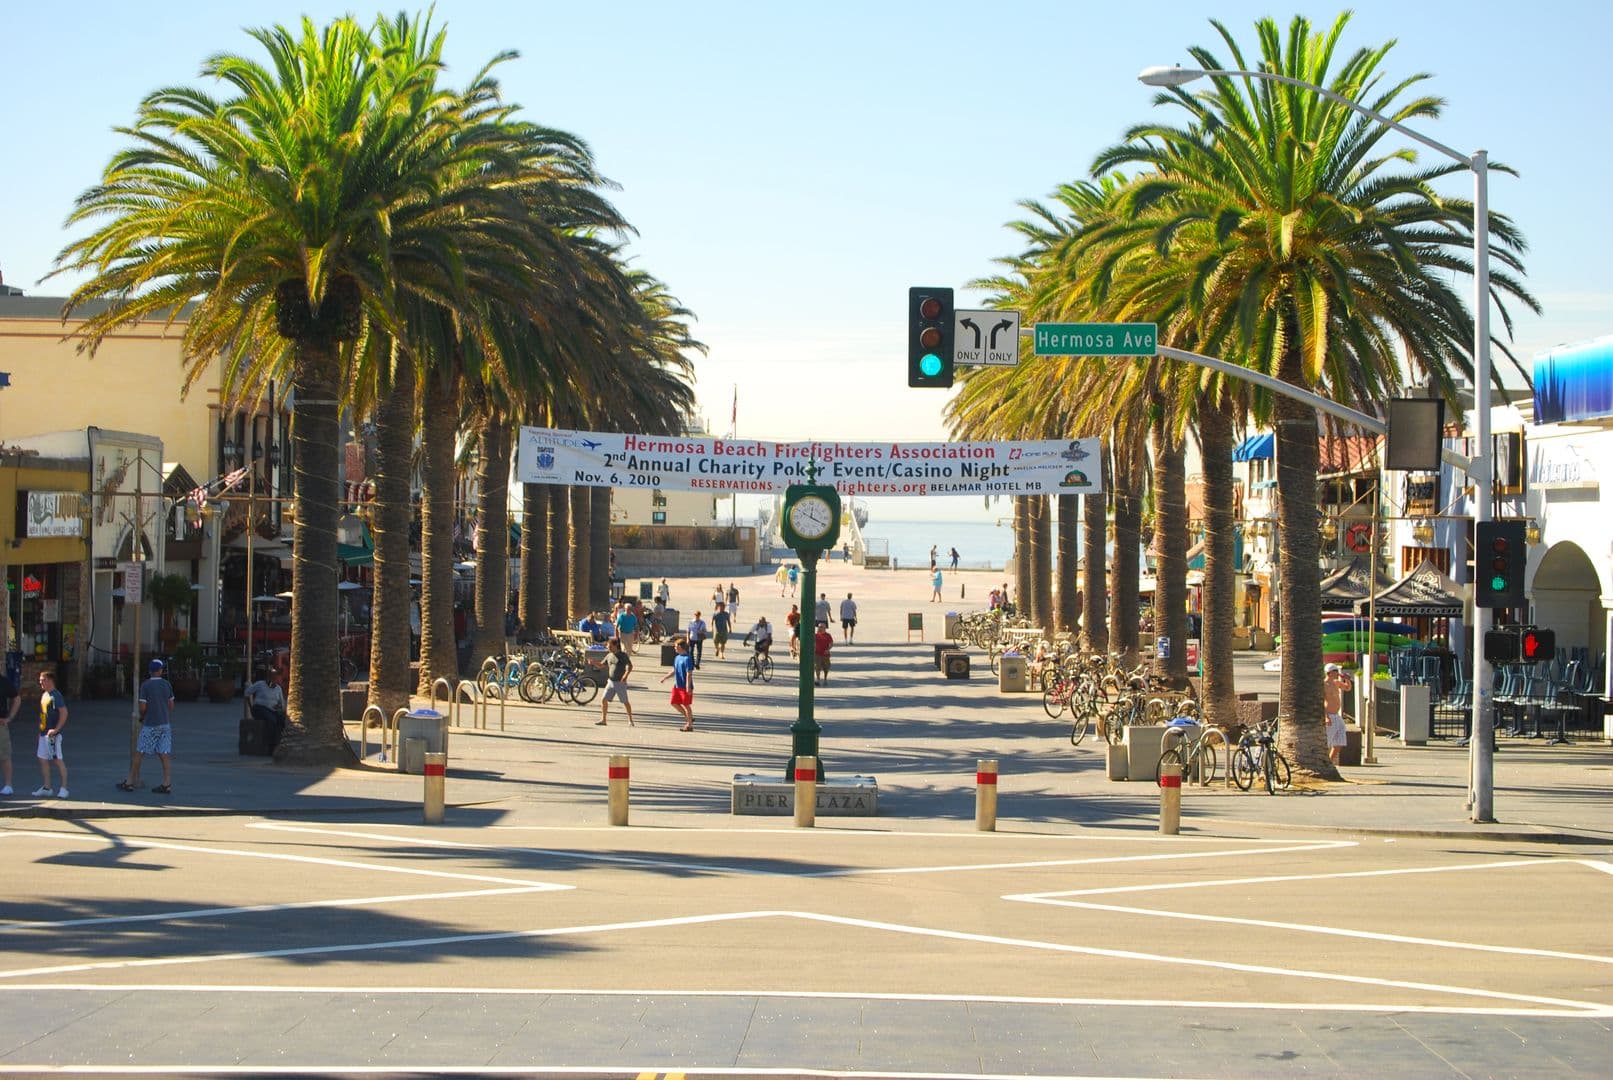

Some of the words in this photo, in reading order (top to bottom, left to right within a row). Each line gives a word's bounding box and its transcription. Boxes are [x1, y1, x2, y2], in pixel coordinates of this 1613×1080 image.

[1039, 331, 1114, 348] Hermosa
[1123, 331, 1153, 348] Ave
[957, 351, 980, 360] ONLY
[989, 352, 1013, 361] ONLY
[624, 435, 705, 455] Hermosa
[713, 440, 767, 457] Beach
[775, 442, 883, 462] Firefighters
[890, 443, 995, 460] Association
[627, 455, 691, 473] Annual
[699, 459, 766, 479] Charity
[773, 461, 826, 477] Pokr
[833, 462, 952, 479] Event/Casino
[961, 461, 1010, 481] Night
[574, 470, 604, 484] Nov.
[629, 473, 661, 487] 2010
[691, 479, 773, 491] RESERVATIONS
[930, 482, 982, 492] BELAMAR
[986, 481, 1022, 491] HOTEL
[1025, 481, 1042, 490] MB
[745, 794, 788, 808] PIER
[816, 796, 866, 809] LAZA
